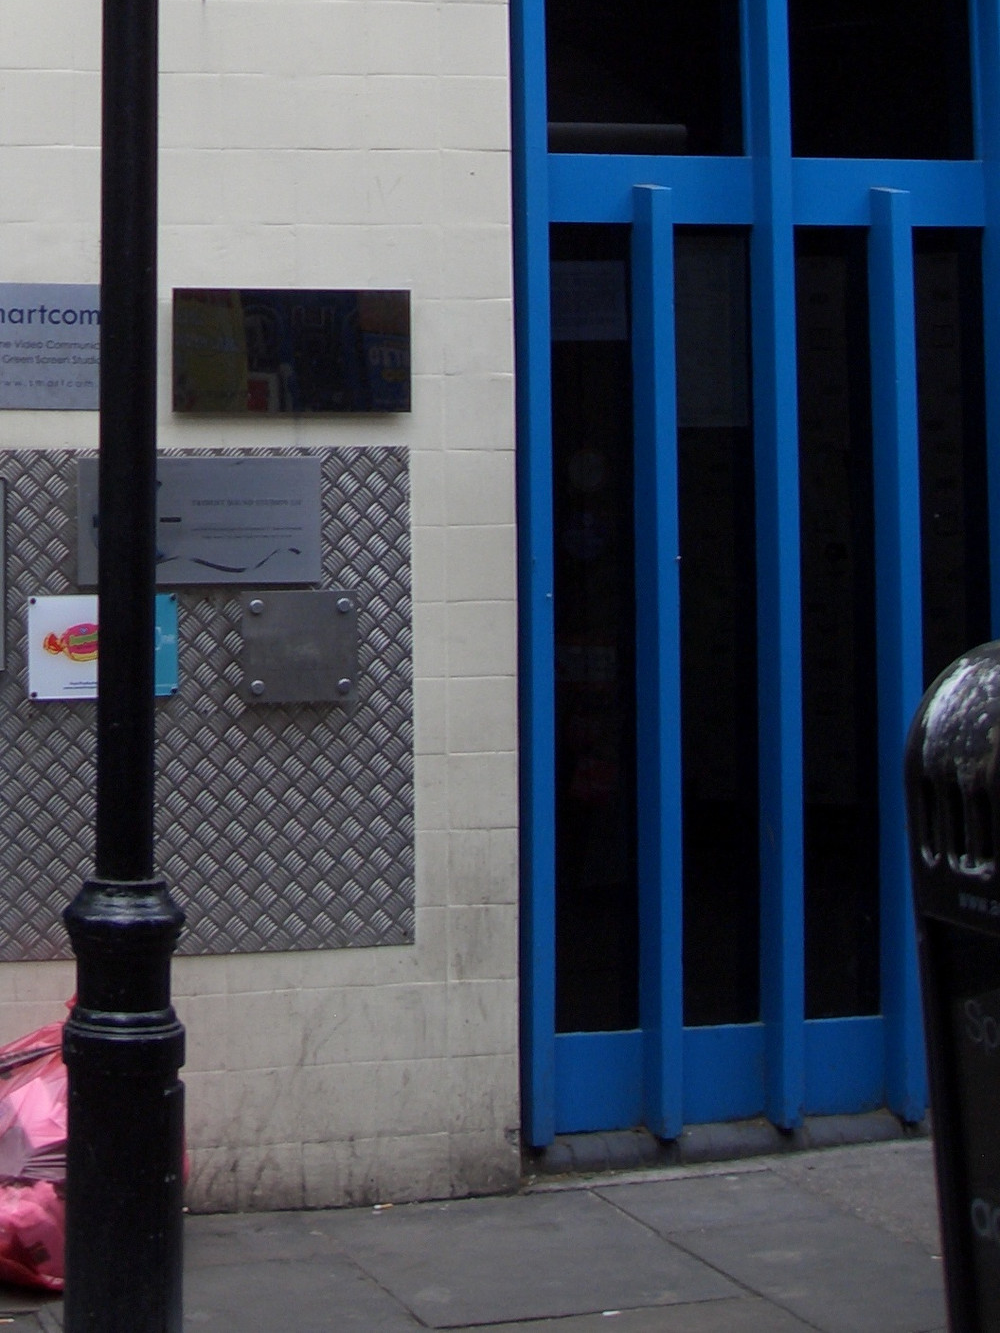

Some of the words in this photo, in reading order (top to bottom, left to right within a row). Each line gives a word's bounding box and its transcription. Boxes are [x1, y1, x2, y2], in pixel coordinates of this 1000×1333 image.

[14, 339, 44, 349] Video
[45, 340, 100, 350] Communic
[2, 354, 33, 364] Green
[34, 355, 69, 365] Screen
